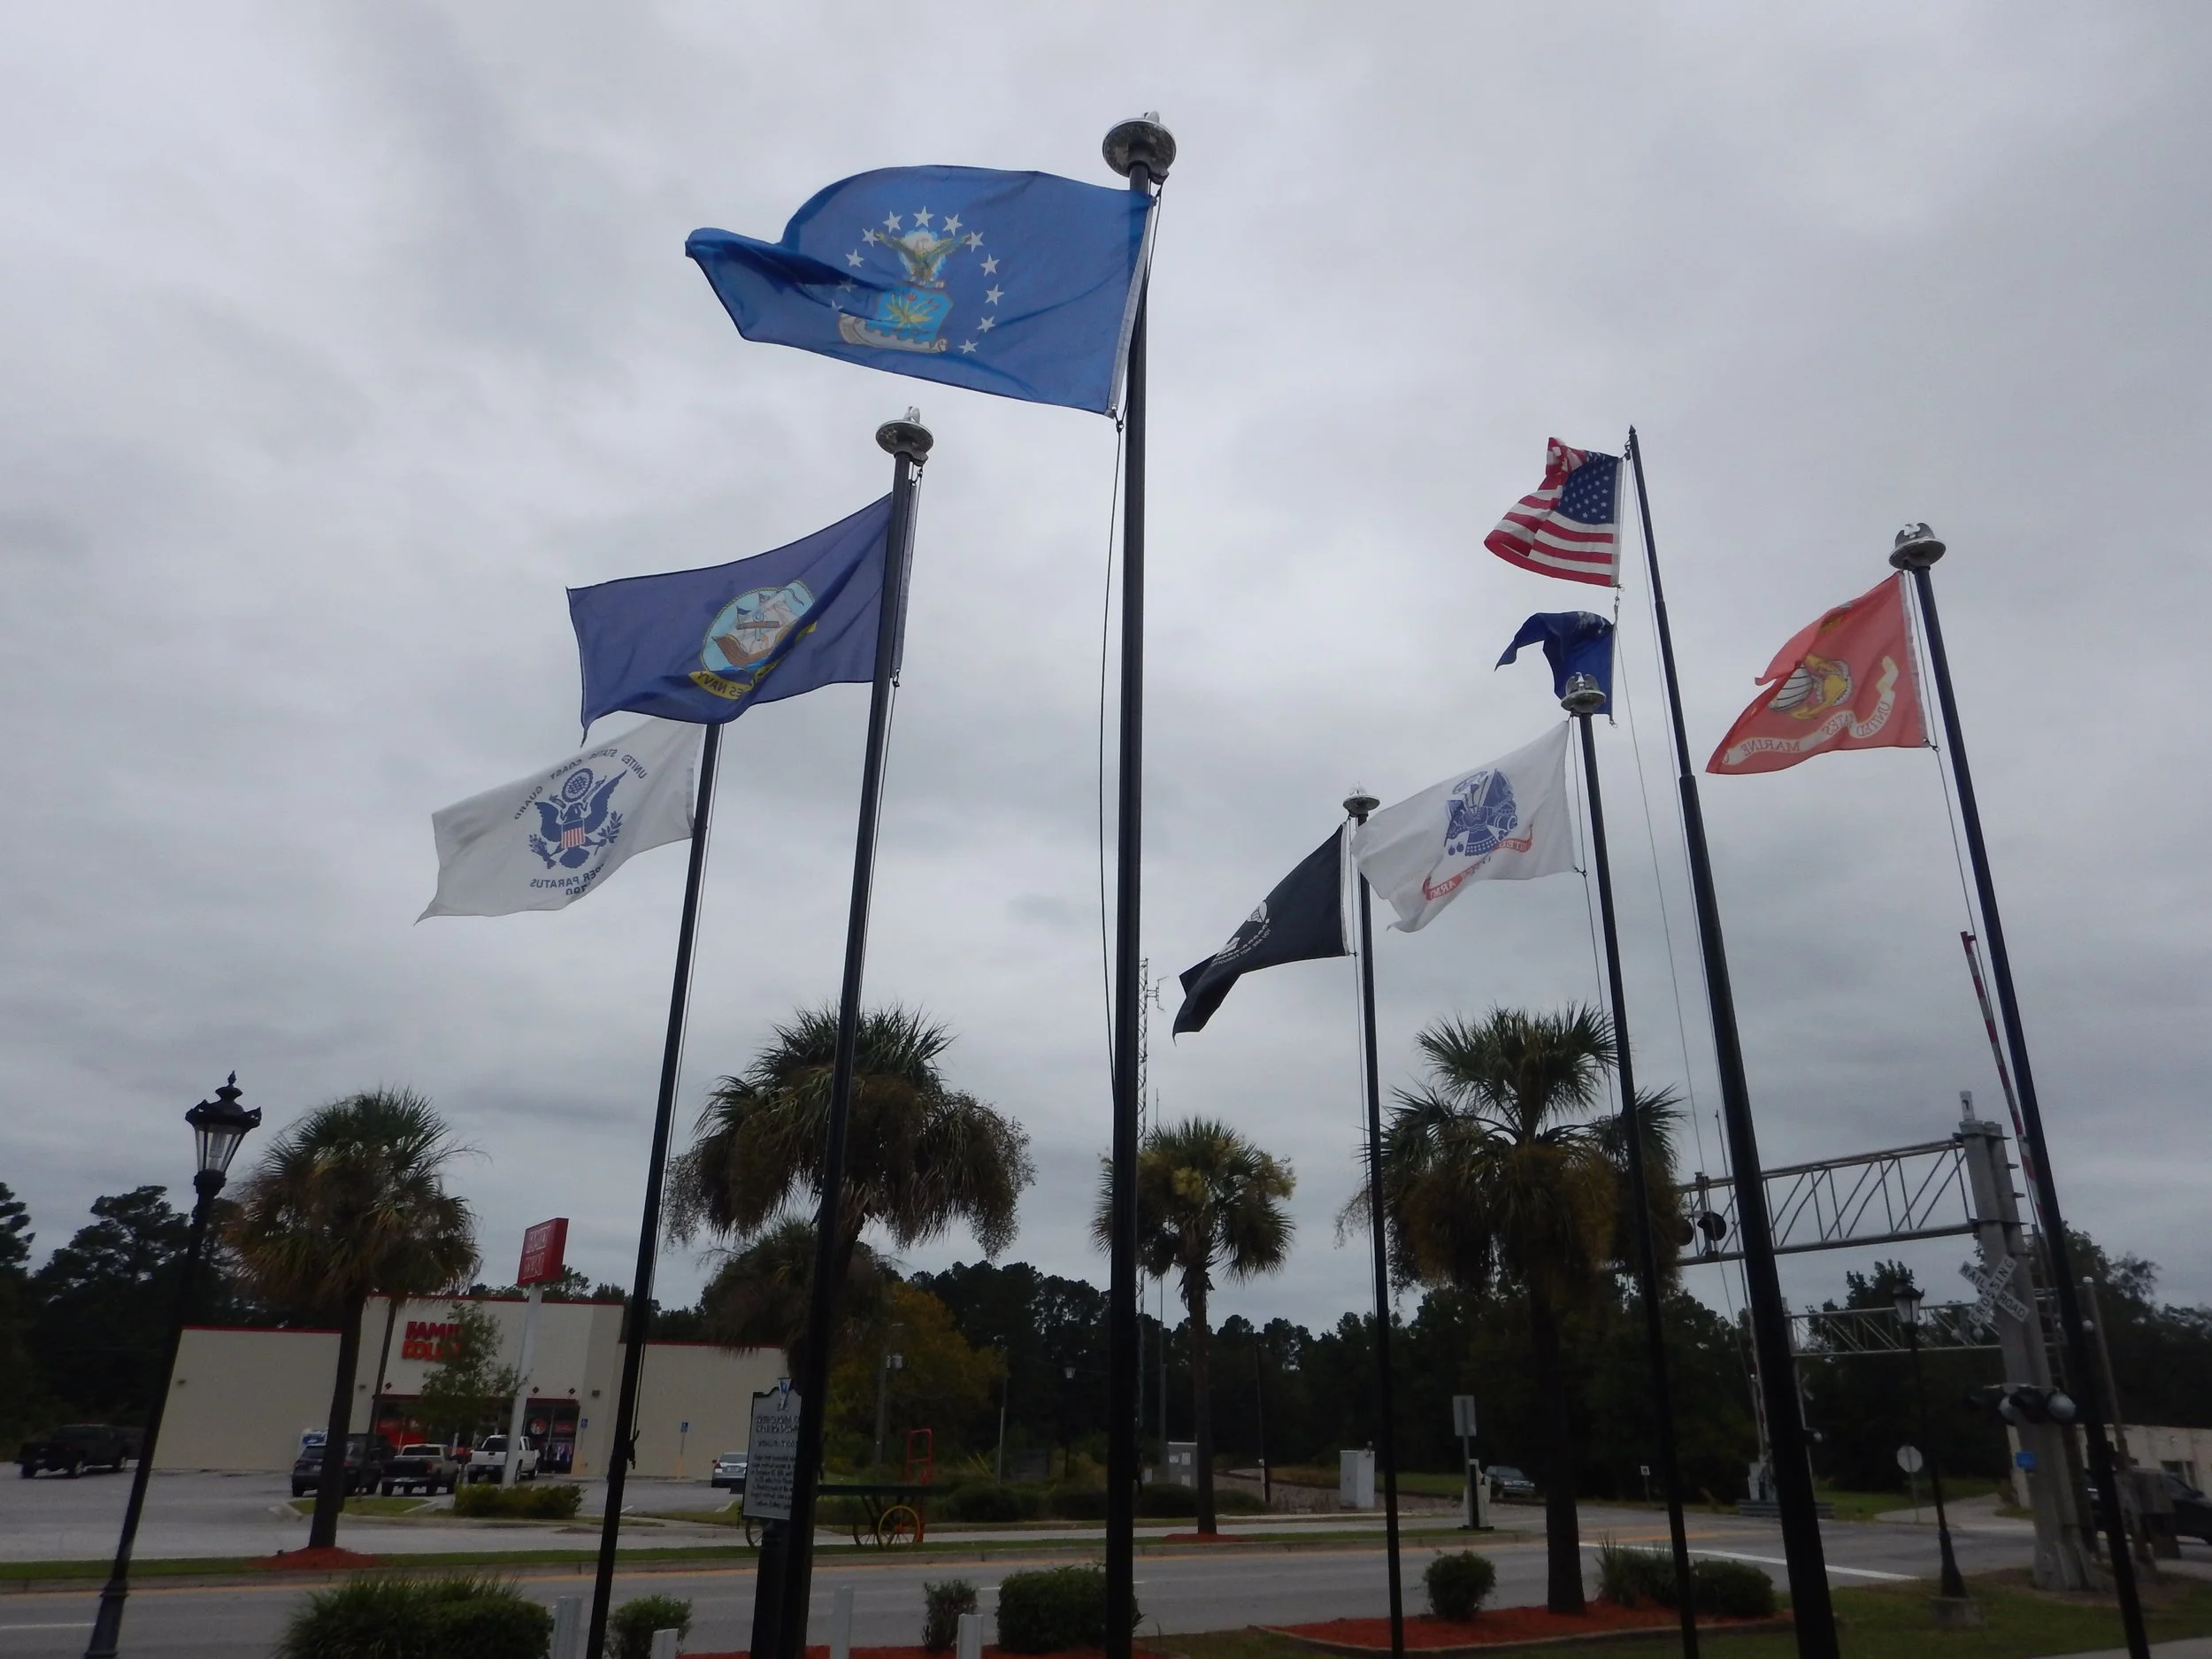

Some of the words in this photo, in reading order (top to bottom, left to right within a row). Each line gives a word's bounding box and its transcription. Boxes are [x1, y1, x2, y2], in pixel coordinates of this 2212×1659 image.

[1961, 1264, 1985, 1289] RAIL
[1998, 1293, 2026, 1318] ROAD
[1970, 1258, 2014, 1324] CROSSING
